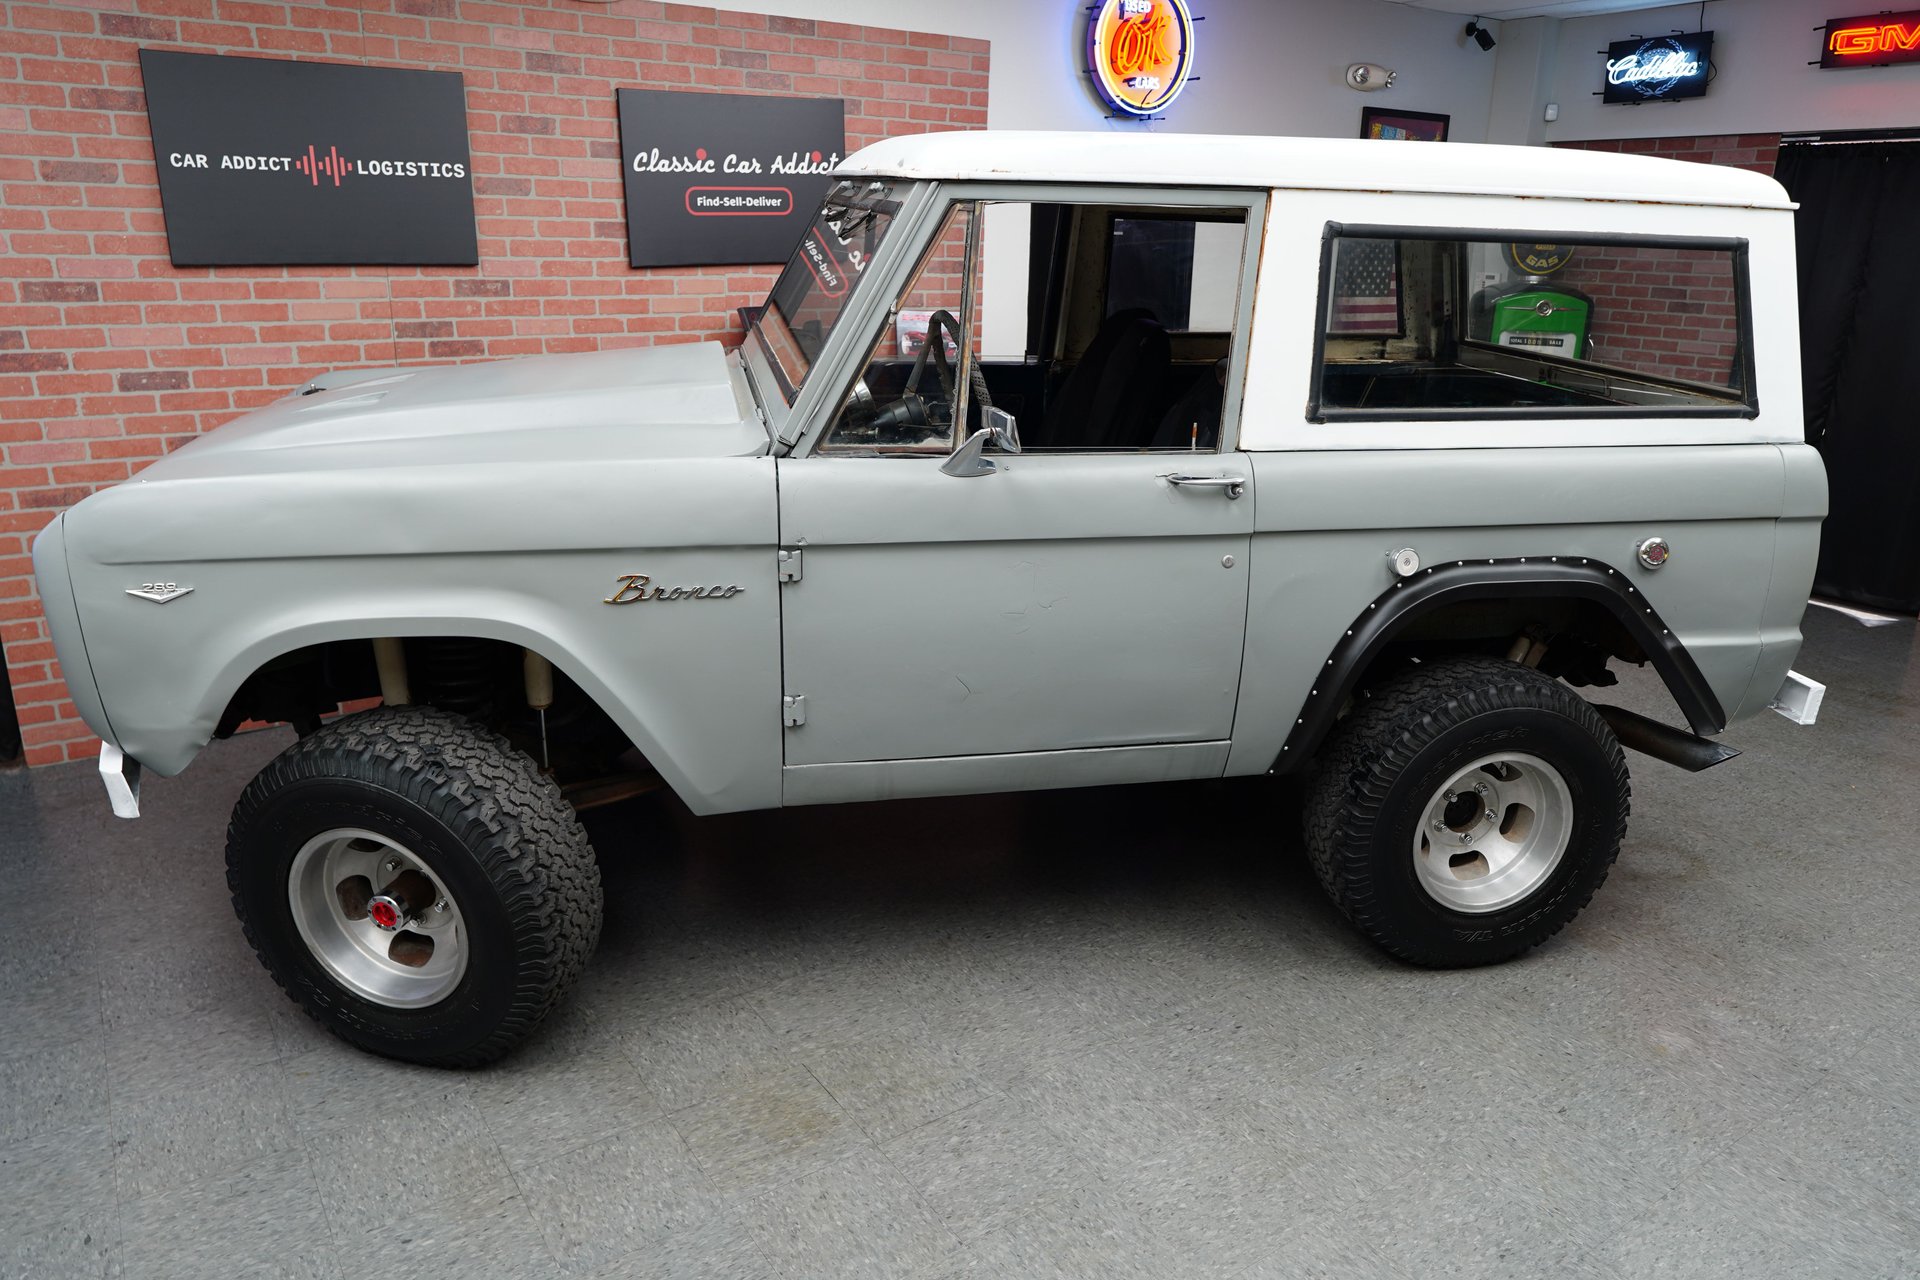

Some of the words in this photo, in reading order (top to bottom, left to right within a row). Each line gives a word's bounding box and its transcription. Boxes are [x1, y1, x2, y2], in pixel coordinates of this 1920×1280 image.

[1112, 2, 1173, 74] OK
[1607, 51, 1698, 85] Cadillac
[170, 153, 208, 168] CAR
[221, 155, 291, 171] ADDICT
[357, 160, 465, 178] LOGISTICS
[633, 148, 716, 173] Classic
[723, 154, 762, 173] Car
[697, 196, 782, 207] Find-Sell-Deliver
[1525, 255, 1559, 268] GAS
[142, 583, 176, 592] 289
[603, 573, 745, 605] Bronco
